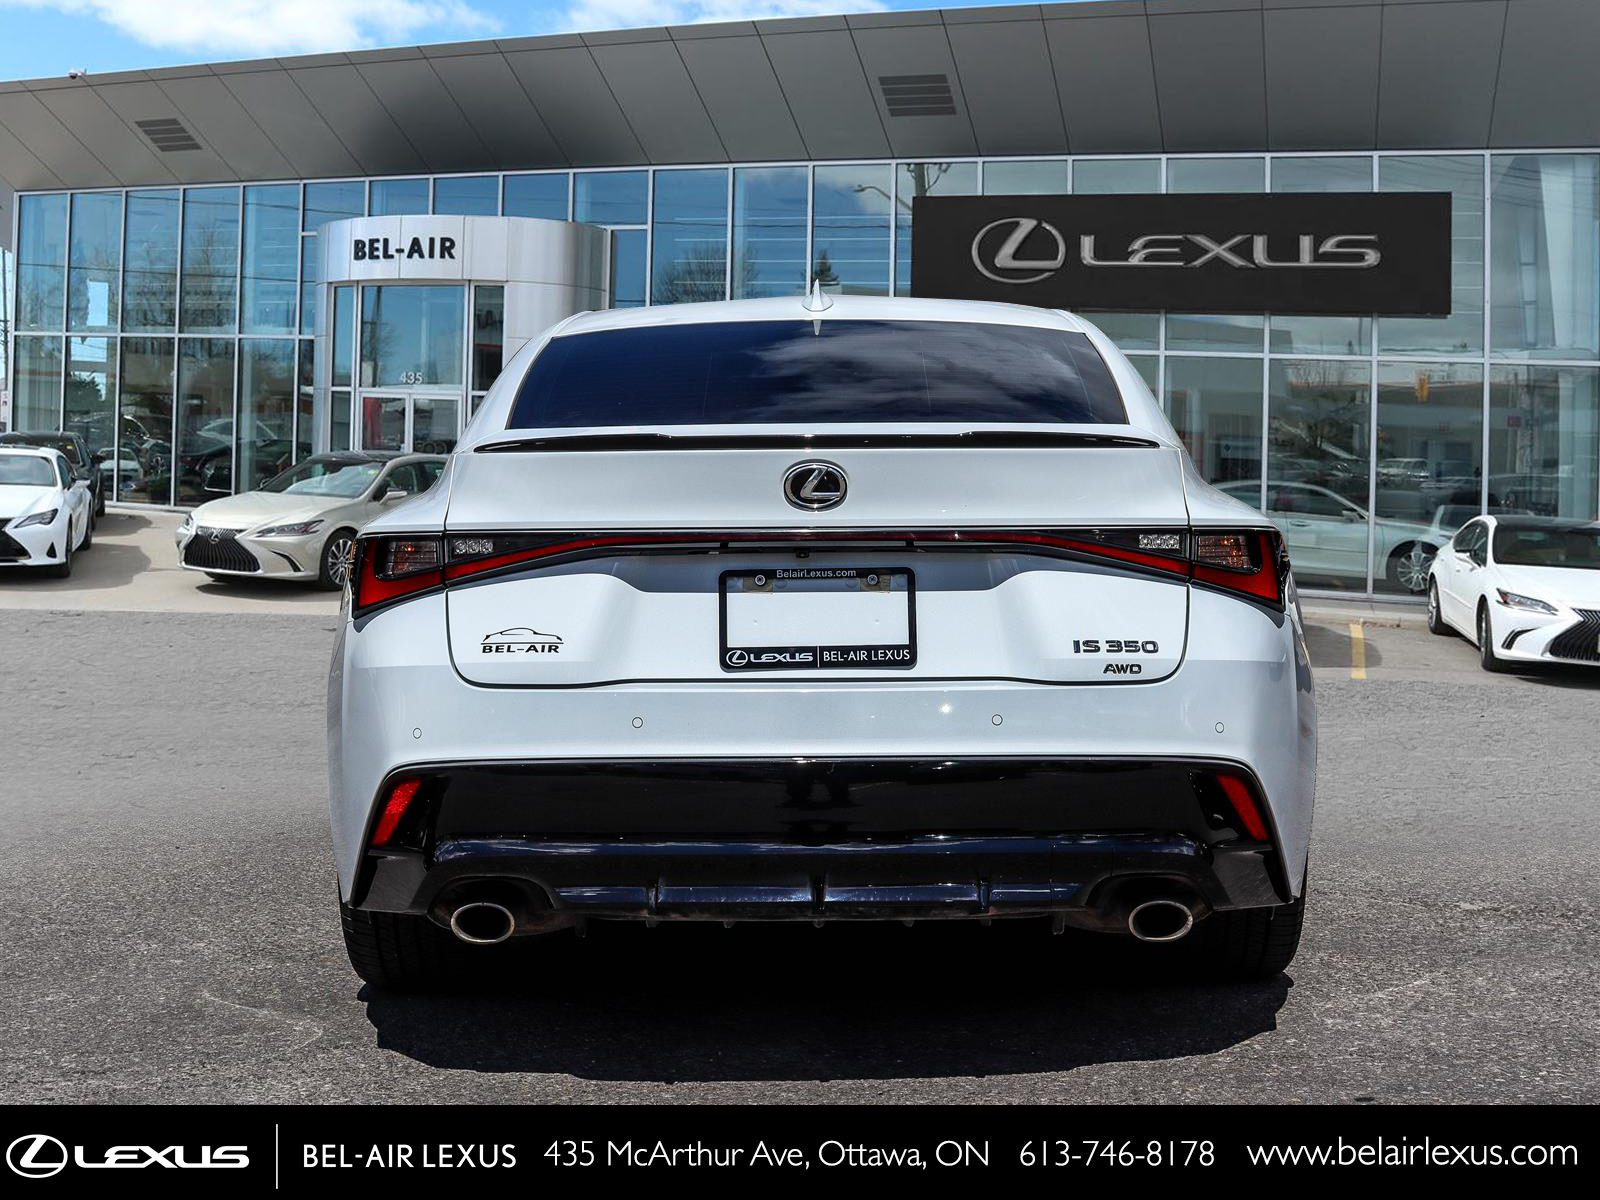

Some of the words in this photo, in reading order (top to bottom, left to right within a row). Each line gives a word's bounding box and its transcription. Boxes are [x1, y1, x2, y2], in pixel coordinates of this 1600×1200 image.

[353, 236, 456, 261] BEL-AIR
[1080, 234, 1382, 269] LEXUS
[400, 371, 423, 384] 435
[776, 569, 857, 579] BelairLexus.com
[482, 644, 560, 654] BEL-AIR
[1072, 639, 1101, 654] IS
[1105, 639, 1159, 654] 350
[750, 652, 814, 663] LEXUS
[823, 650, 868, 662] BEL-AIR
[871, 649, 910, 661] LEXUS
[1102, 663, 1142, 675] AWD
